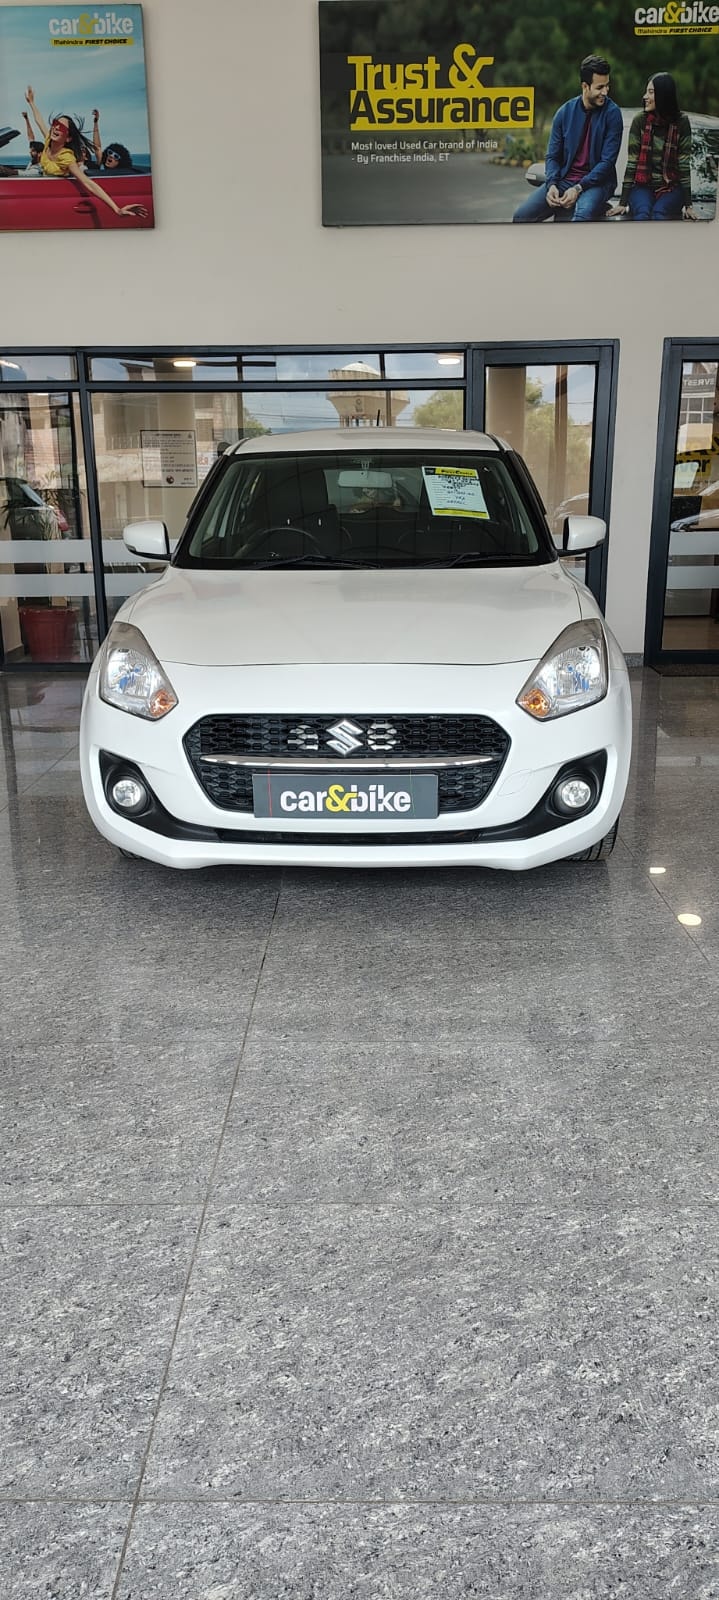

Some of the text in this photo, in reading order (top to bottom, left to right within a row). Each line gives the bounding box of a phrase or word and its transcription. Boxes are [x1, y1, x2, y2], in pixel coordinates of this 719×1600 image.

[48, 12, 134, 35] car&bike
[634, 1, 719, 24] car&bike
[347, 43, 494, 90] Trust &
[351, 90, 530, 124] Assurance
[351, 139, 498, 150] Most loved Used Car brand of India
[357, 154, 368, 164] By
[371, 153, 411, 163] Franchise
[413, 153, 437, 163] India,
[439, 153, 450, 162] ET
[280, 784, 411, 812] car&bike
